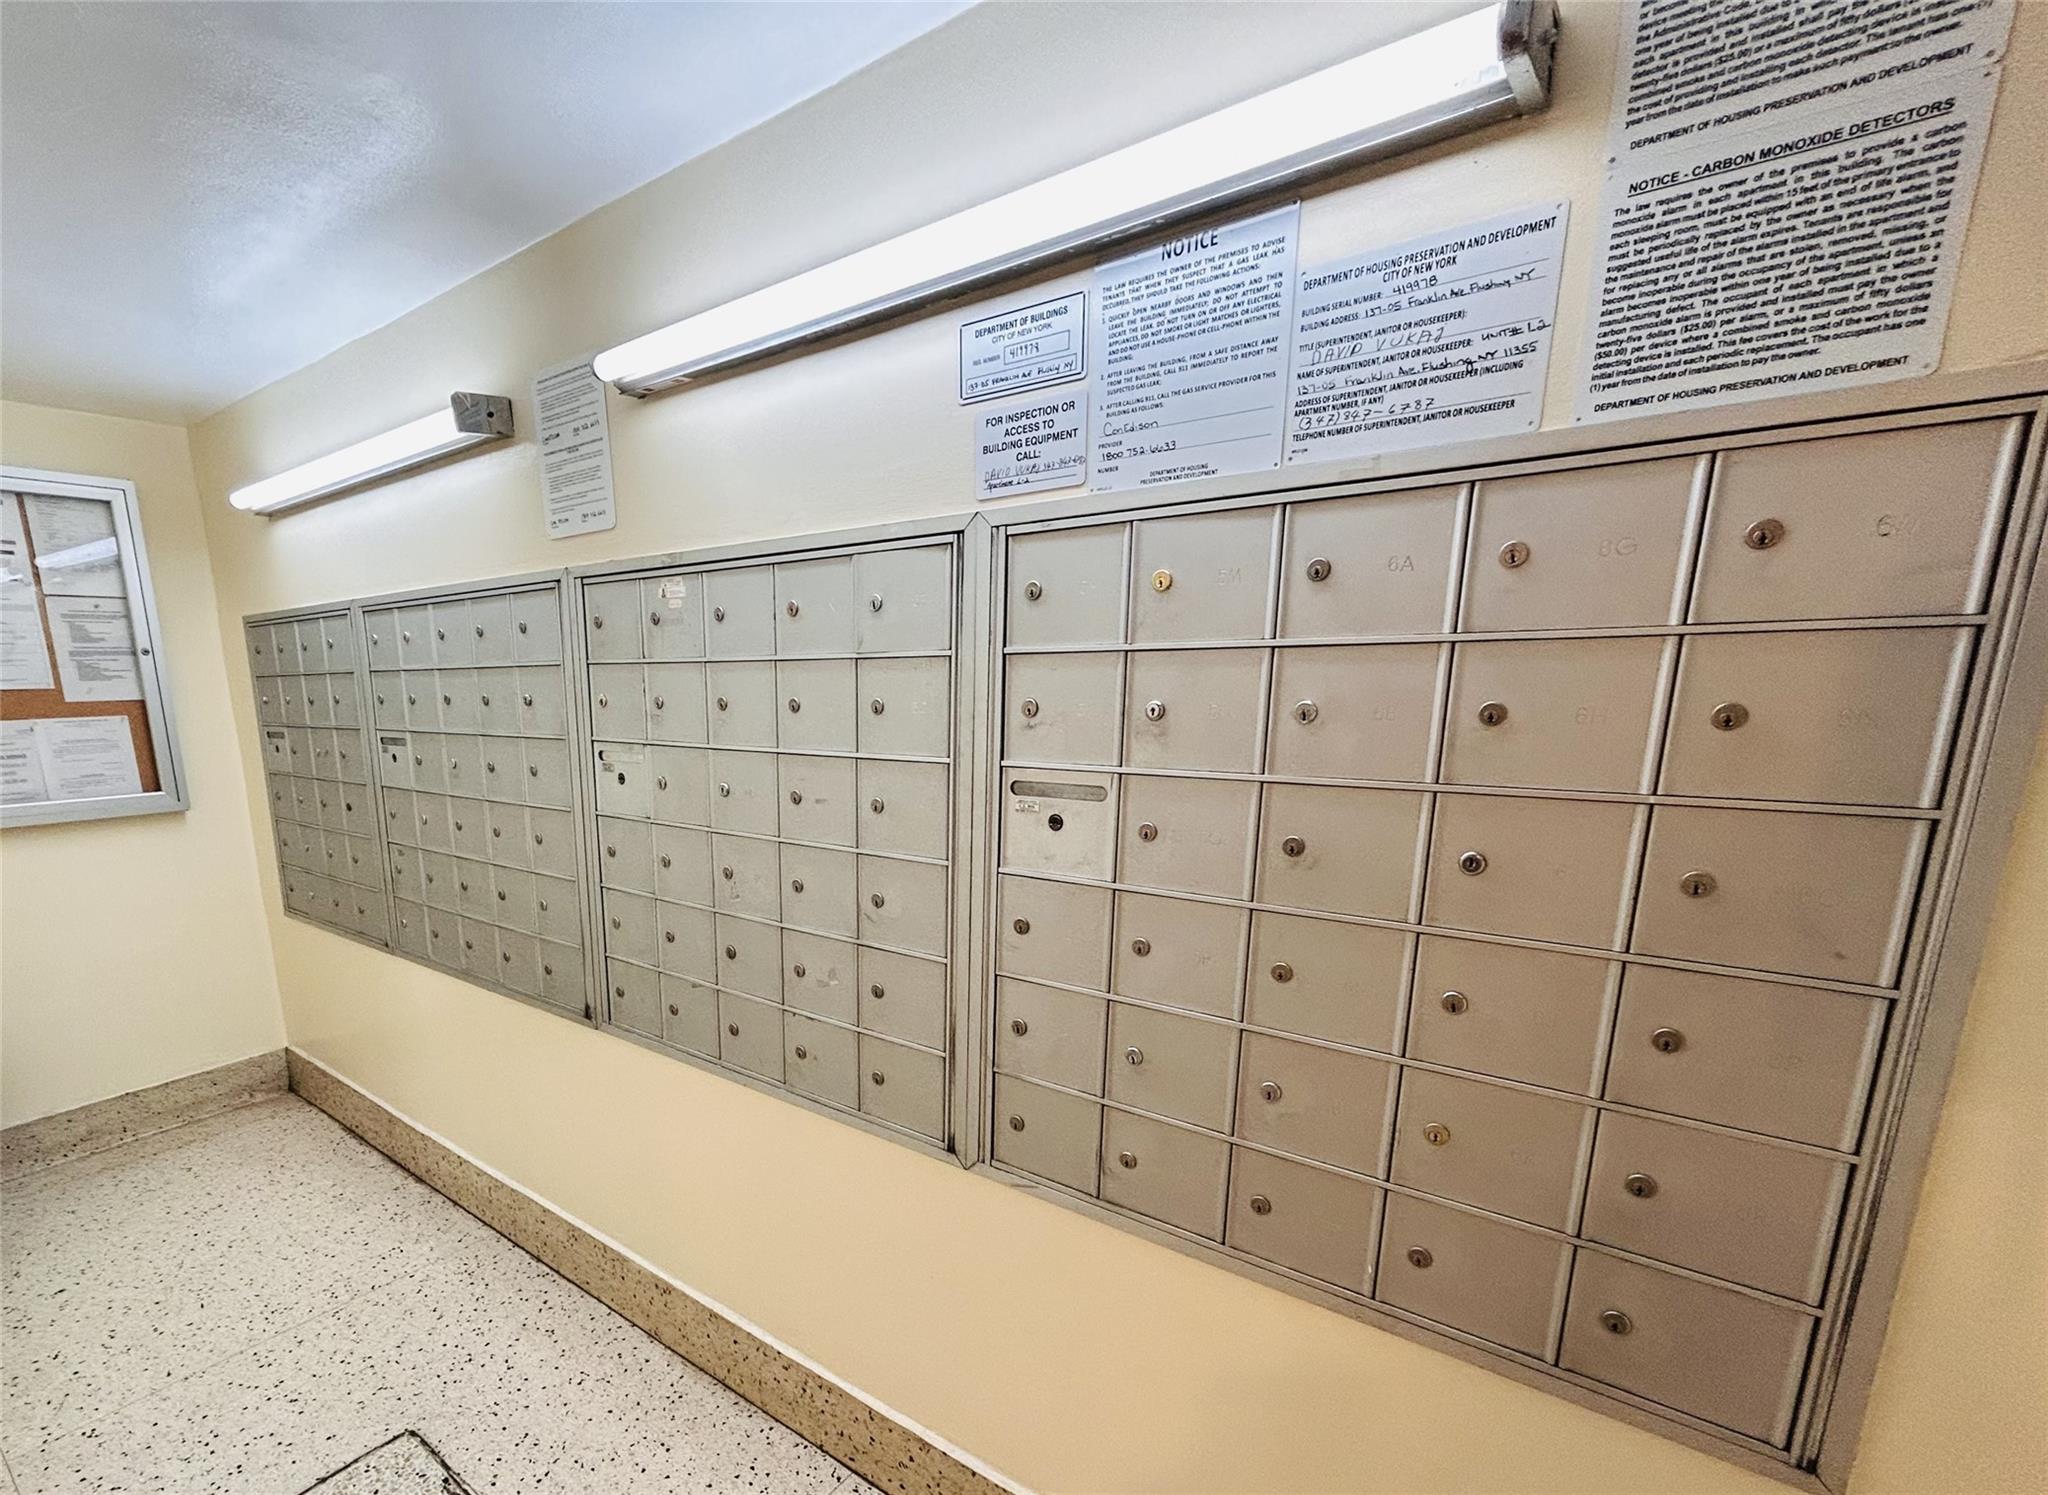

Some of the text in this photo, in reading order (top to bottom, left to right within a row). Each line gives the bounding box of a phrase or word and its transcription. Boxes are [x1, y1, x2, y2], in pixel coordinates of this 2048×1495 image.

[1630, 43, 1974, 150] DEPARTMENT OF HOUSING PRESERVATION AND DEVELOPMENT
[1629, 171, 1680, 193] NOTICE
[1692, 152, 1755, 177] CARBON
[1759, 128, 1844, 160] MONOXIDE
[1848, 97, 1955, 136] DETECTORS
[1615, 208, 1631, 217] The
[1635, 203, 1651, 211] law
[1656, 192, 1693, 206] requires
[1698, 187, 1713, 196] the
[1718, 178, 1748, 191] owner
[1753, 172, 1764, 182] of
[1769, 169, 1785, 178] the
[1790, 155, 1839, 175] premises
[1845, 151, 1857, 159] to
[1862, 137, 1905, 157] provide
[1925, 121, 1967, 139] carbon
[1161, 229, 1218, 261] NOTICE
[1304, 216, 1557, 291] DEPARTMENT OF HOUSING PRESERVATION AND DEVELOPMENT
[1383, 255, 1457, 283] CITY OF NEW YORK
[1393, 275, 1438, 295] 419978
[1302, 292, 1381, 317] BUILDING SERIAL NUMBER:
[1365, 301, 1401, 318] 137-05
[975, 305, 1068, 338] DEPARTMENT OF BUILDINGS
[992, 323, 1052, 344] CITY OF NEW YORK
[1299, 310, 1465, 352] TITLE (SUPERINTENDENT, JANITOR OR HOUSEKEEPER):
[1301, 312, 1358, 332] BUILDING ADDRESS:
[1528, 319, 1551, 332] L2
[1596, 318, 1736, 349] twenty-five dollars ($25.00) per
[1124, 365, 1145, 375] LEAVING
[1190, 352, 1206, 360] FROM
[1215, 347, 1227, 355] SAFE
[1231, 341, 1258, 352] DISTANCE
[1261, 336, 1278, 345] AWAY
[1297, 339, 1472, 380] NAME OF SUPERINTENDENT, JANITOR OR HOUSEKEEPER:
[1298, 382, 1336, 396] 137-05
[1345, 371, 1394, 386] Franklin
[1504, 340, 1538, 357] 11355
[1311, 342, 1362, 366] DAVID
[1295, 397, 1321, 408] ADDRESS
[1322, 395, 1330, 404] OF
[1332, 385, 1387, 402] SUPERINTENDENT,
[1389, 380, 1417, 391] JANITOR
[1418, 378, 1428, 387] OR
[1480, 360, 1523, 376] (INCLUDING
[1590, 383, 1601, 393] (1)
[1601, 382, 1620, 392] year
[1621, 378, 1641, 386] from
[1658, 372, 1676, 380] date
[1678, 368, 1688, 377] of
[1688, 361, 1739, 375] installation
[1751, 356, 1769, 366] pay
[1771, 354, 1786, 362] the
[1788, 348, 1820, 359] owner.
[1594, 355, 1909, 412] DEPARTMENT OF HOUSING PRESERVATION AND DEVELOPMENT
[1123, 397, 1143, 406] CALLING
[1195, 383, 1217, 392] SERVICE
[1218, 377, 1248, 387] PROVIDER
[986, 400, 1075, 428] FOR INSPECTION OR
[1294, 405, 1330, 417] APARTMENT
[1332, 400, 1359, 410] NUMBER,
[1368, 395, 1384, 404] ANY)
[1004, 419, 1054, 437] ACCESS TO
[1104, 421, 1159, 437] ConEdison
[1293, 399, 1515, 442] TELEPHONE NUMBER OF SUPERINTENDENT, JANITOR OR HOUSEKEEPER
[983, 428, 1078, 455] BUILDING EQUIPMENT
[1098, 441, 1122, 449] PROVIDER
[1016, 450, 1041, 462] CALL:
[1102, 451, 1123, 461] 1800
[1150, 467, 1179, 477] DEPARTMENT
[1188, 463, 1208, 471] HOUSING
[1140, 476, 1172, 484] PRESERVATION
[1184, 469, 1218, 479] DEVELOPMENT
[1387, 554, 1414, 572] 6A
